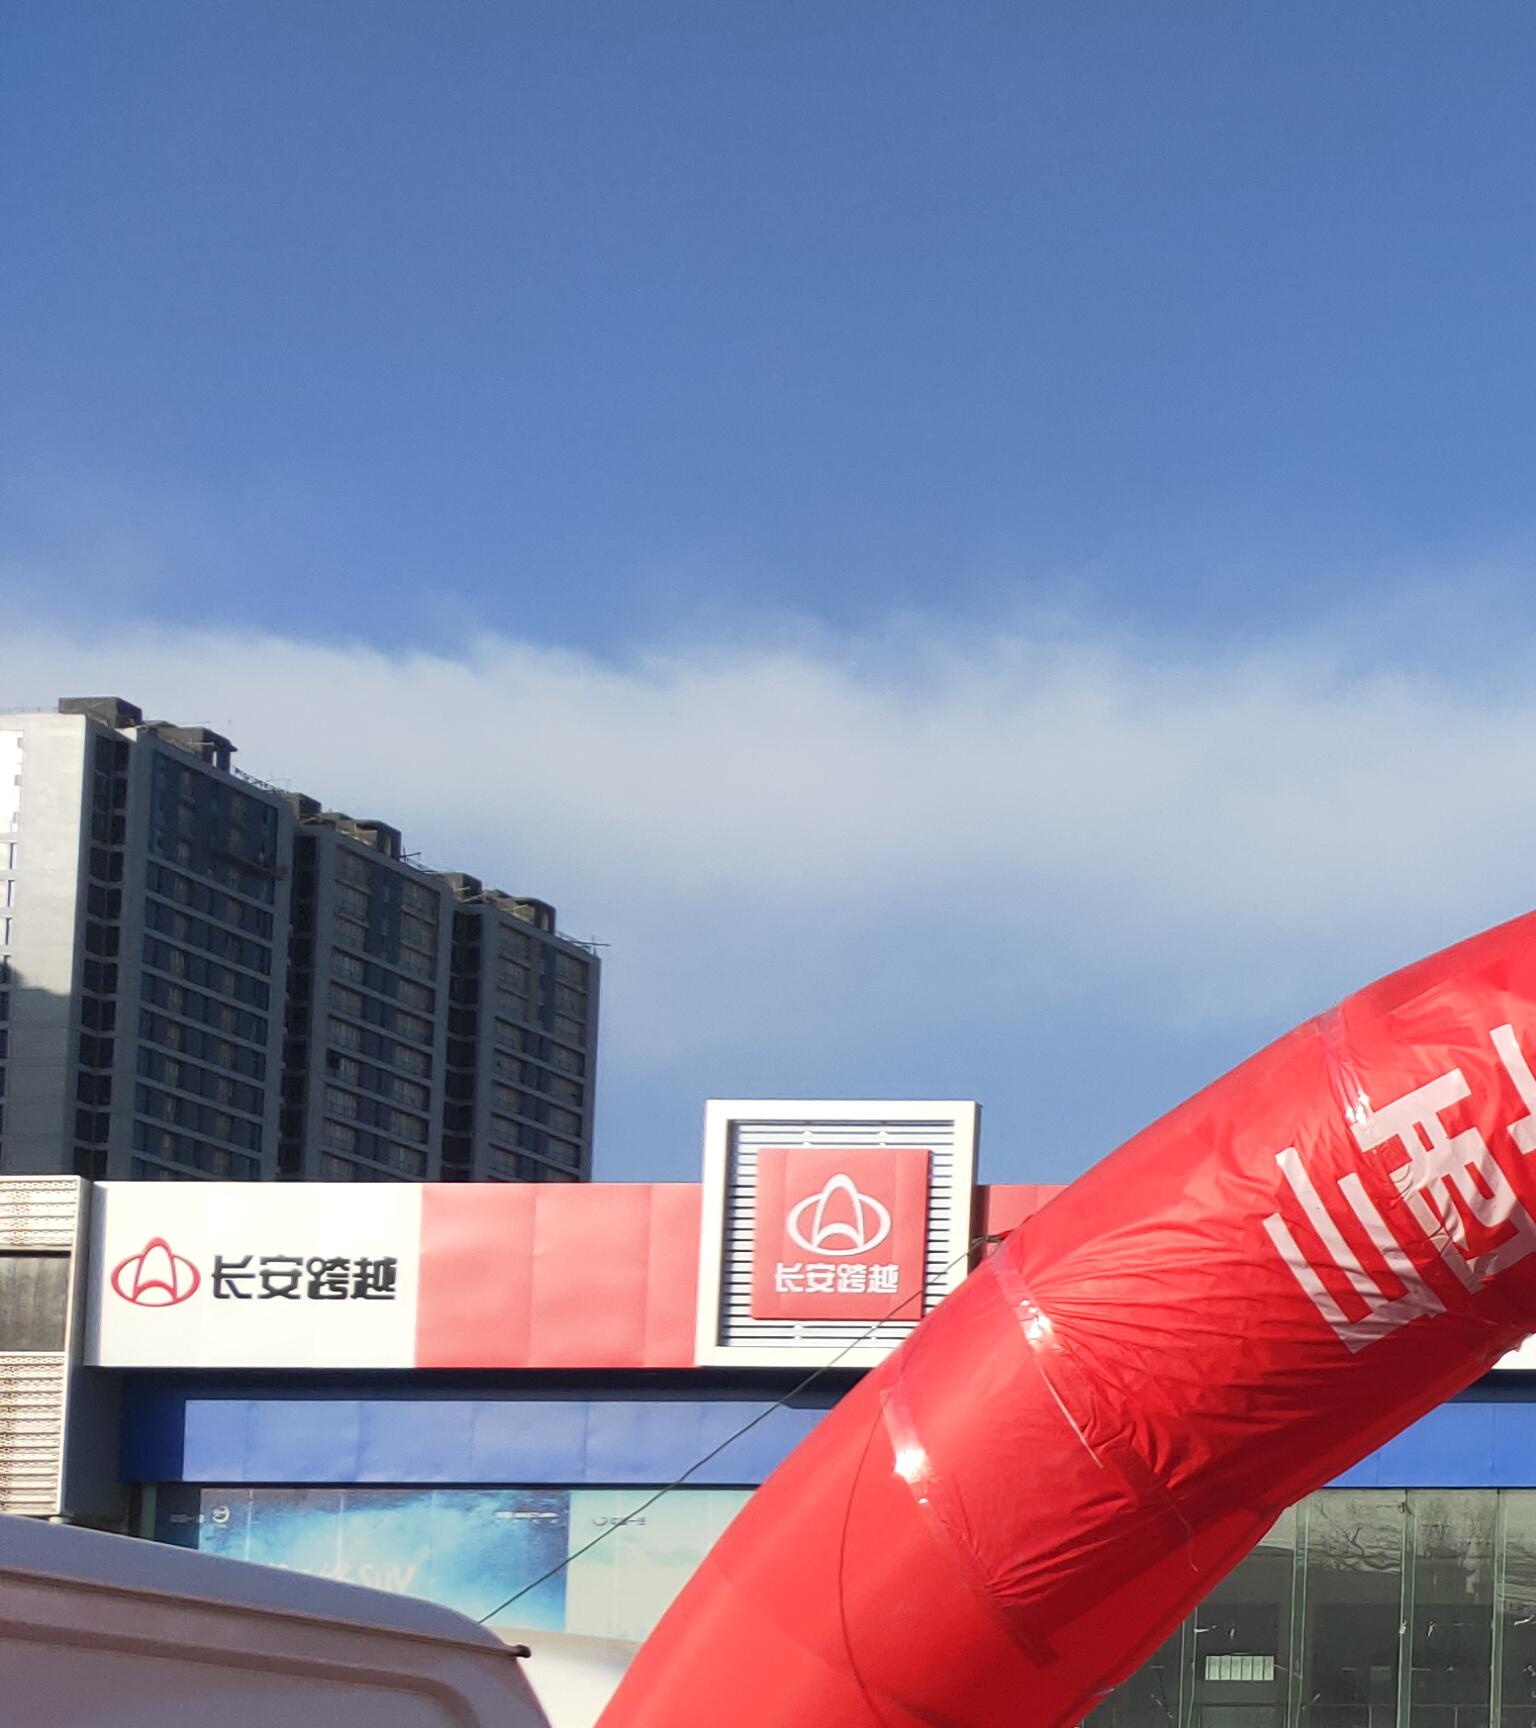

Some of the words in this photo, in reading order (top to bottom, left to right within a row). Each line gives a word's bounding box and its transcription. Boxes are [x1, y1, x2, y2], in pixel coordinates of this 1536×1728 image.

[211, 1255, 397, 1300] 长安跨越
[773, 1261, 900, 1295] 长安跨越
